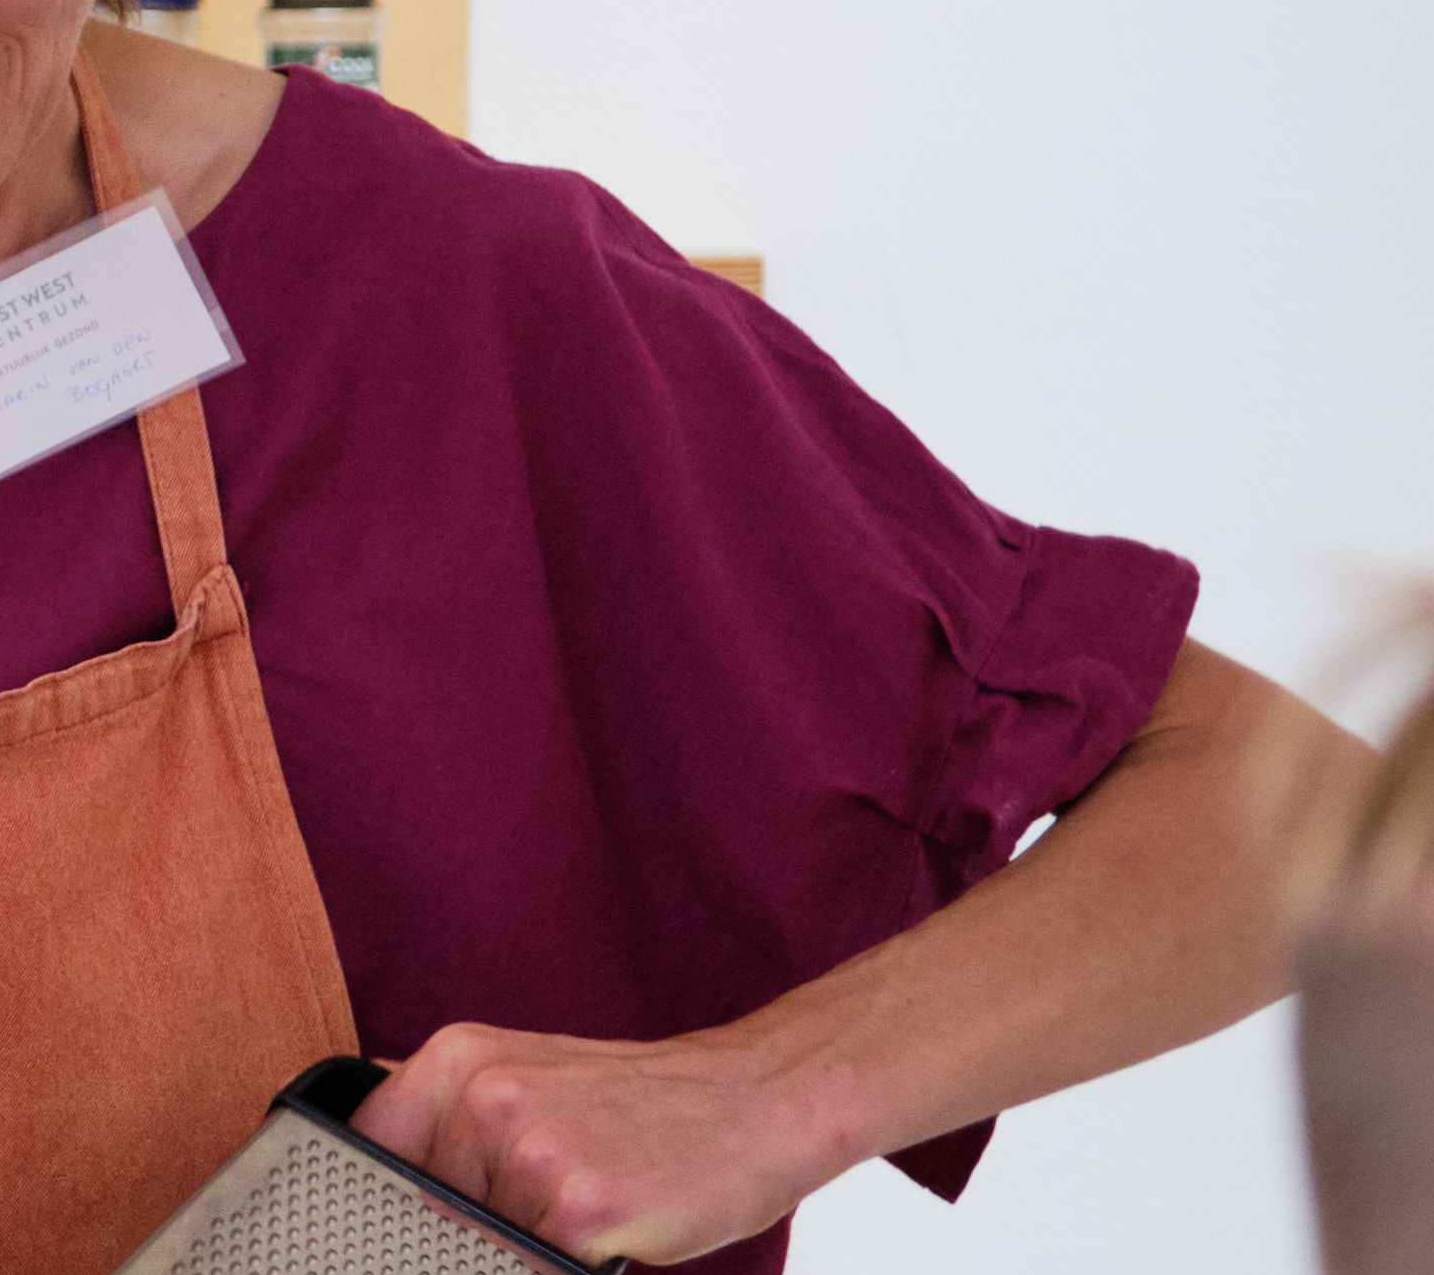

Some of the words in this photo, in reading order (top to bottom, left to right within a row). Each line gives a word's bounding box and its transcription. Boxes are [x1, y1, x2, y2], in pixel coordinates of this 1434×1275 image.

[20, 270, 77, 307] WEST
[53, 320, 100, 350] GEZOND
[69, 352, 100, 377] VAN
